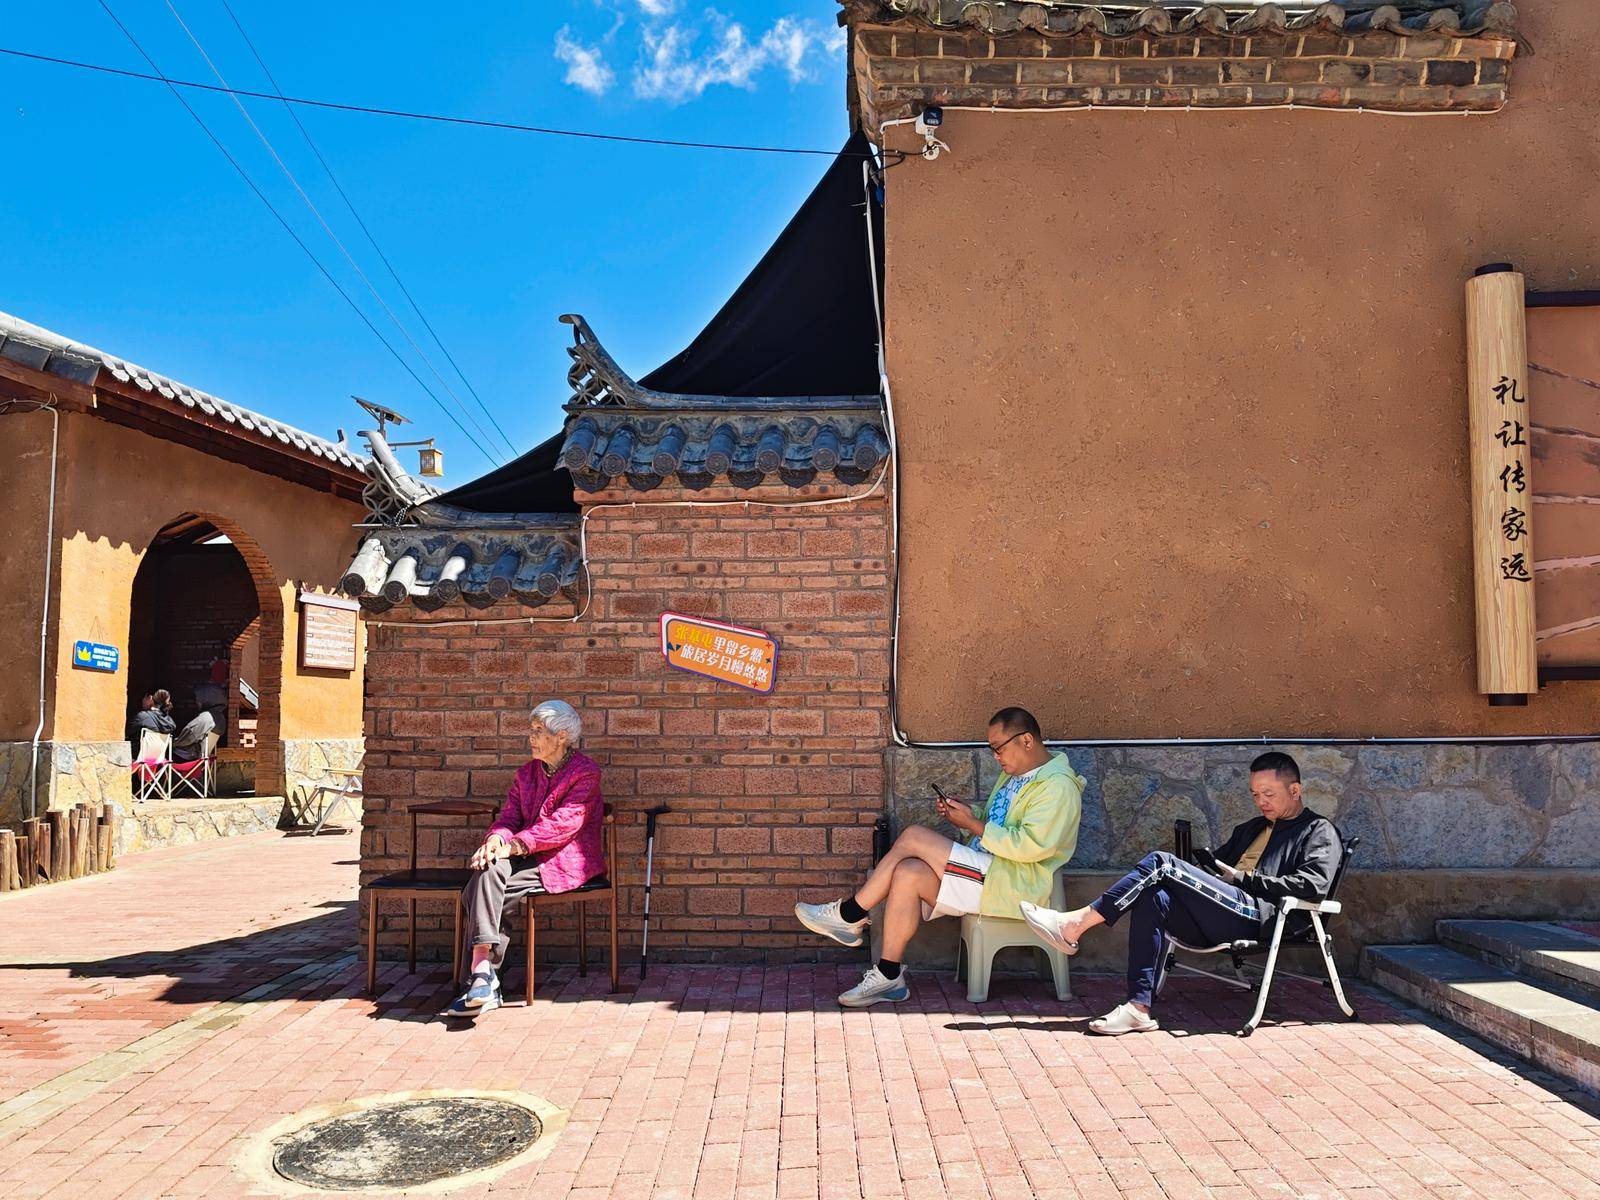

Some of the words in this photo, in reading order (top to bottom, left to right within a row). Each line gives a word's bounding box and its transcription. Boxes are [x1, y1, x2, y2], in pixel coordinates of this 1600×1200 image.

[1492, 376, 1532, 582] 礼让传家远
[680, 643, 769, 683] 旅居岁月慢悠悠
